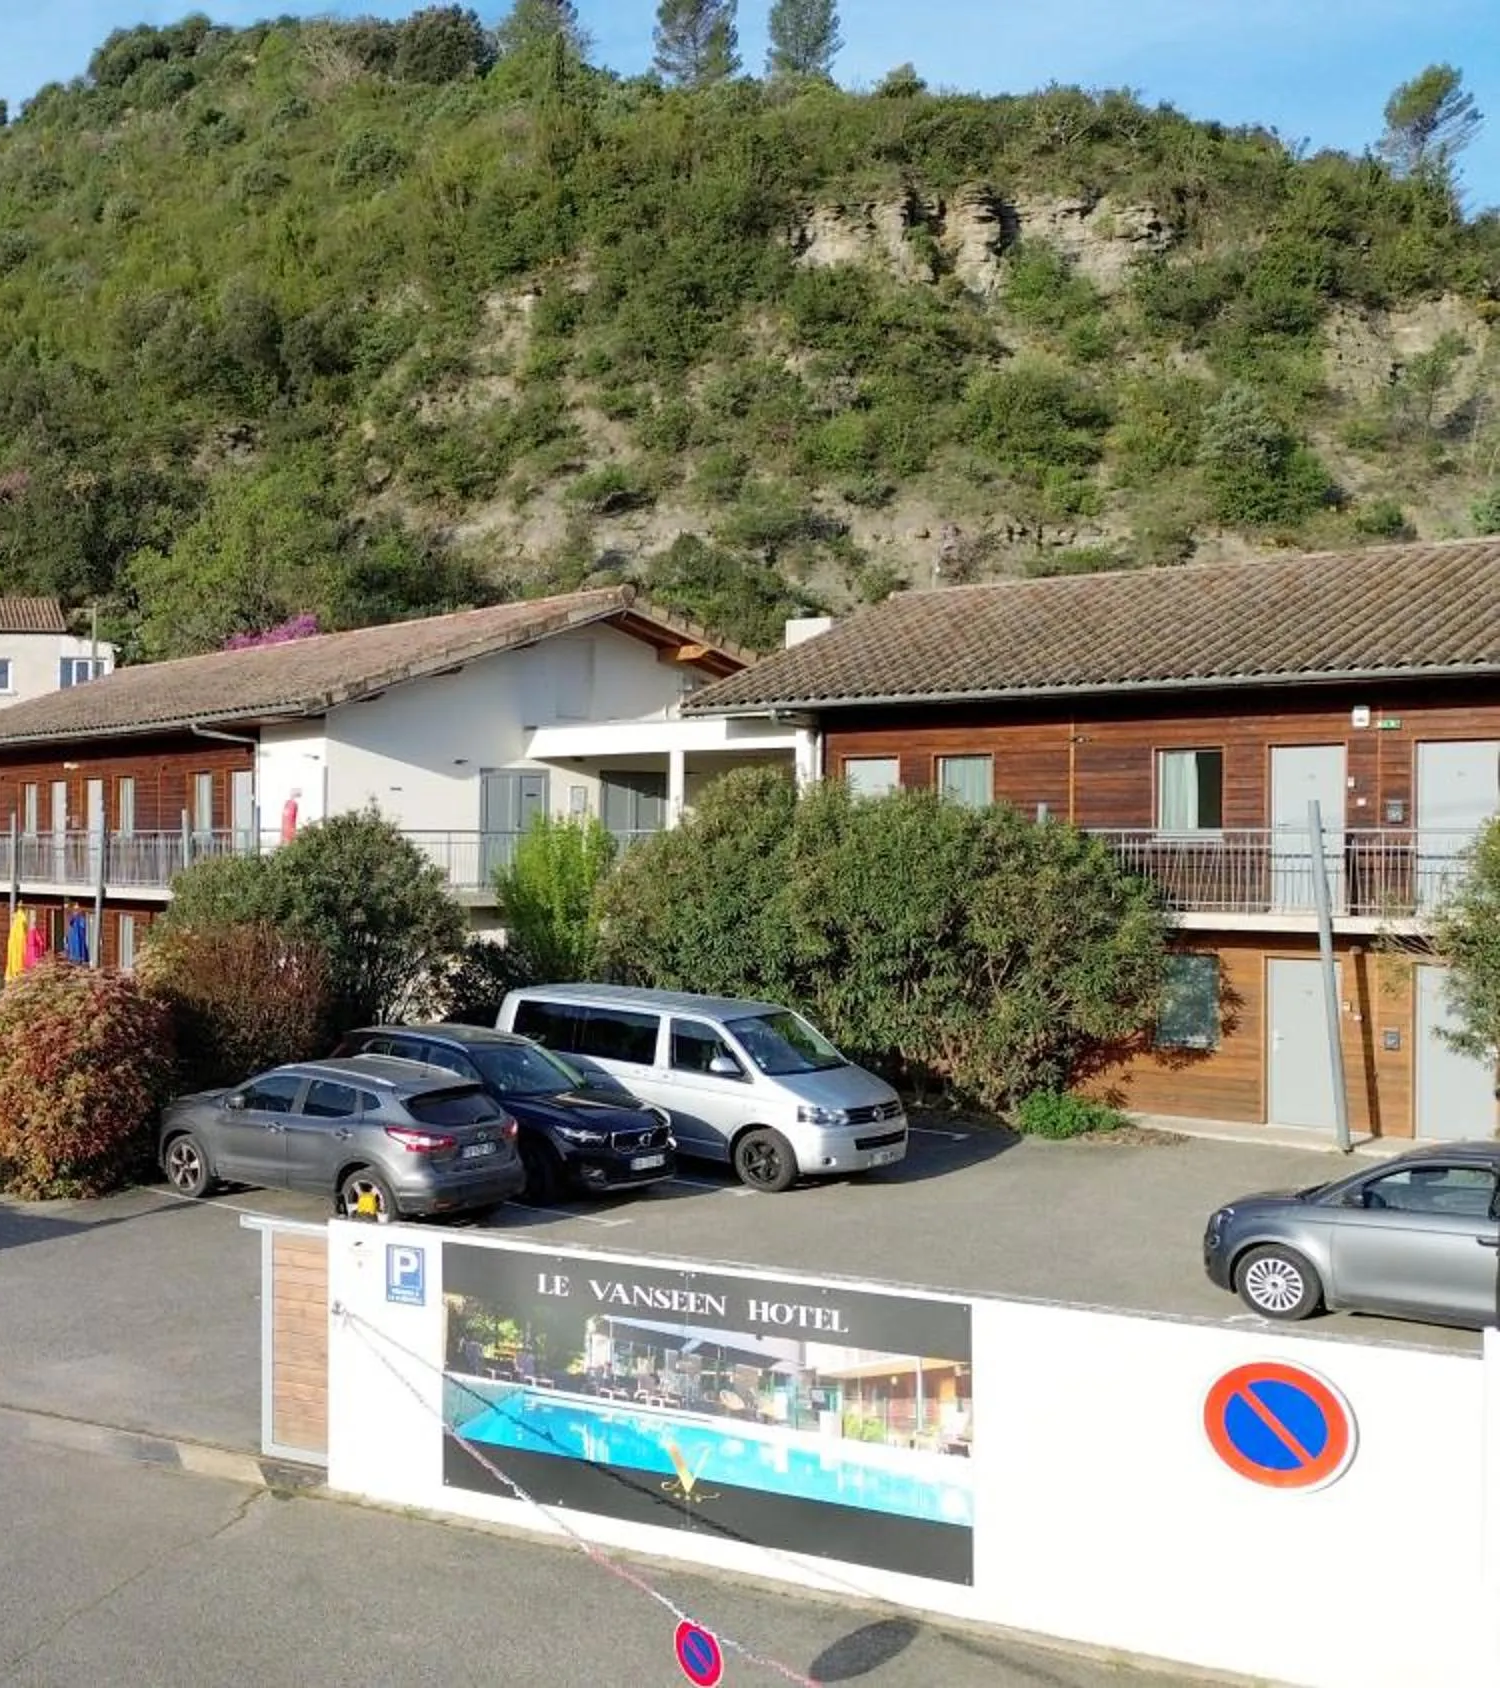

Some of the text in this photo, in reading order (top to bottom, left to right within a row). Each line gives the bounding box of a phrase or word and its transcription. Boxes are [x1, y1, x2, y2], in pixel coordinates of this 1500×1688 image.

[393, 1249, 419, 1285] P
[537, 1273, 849, 1334] LE VANSEEN HOTEL
